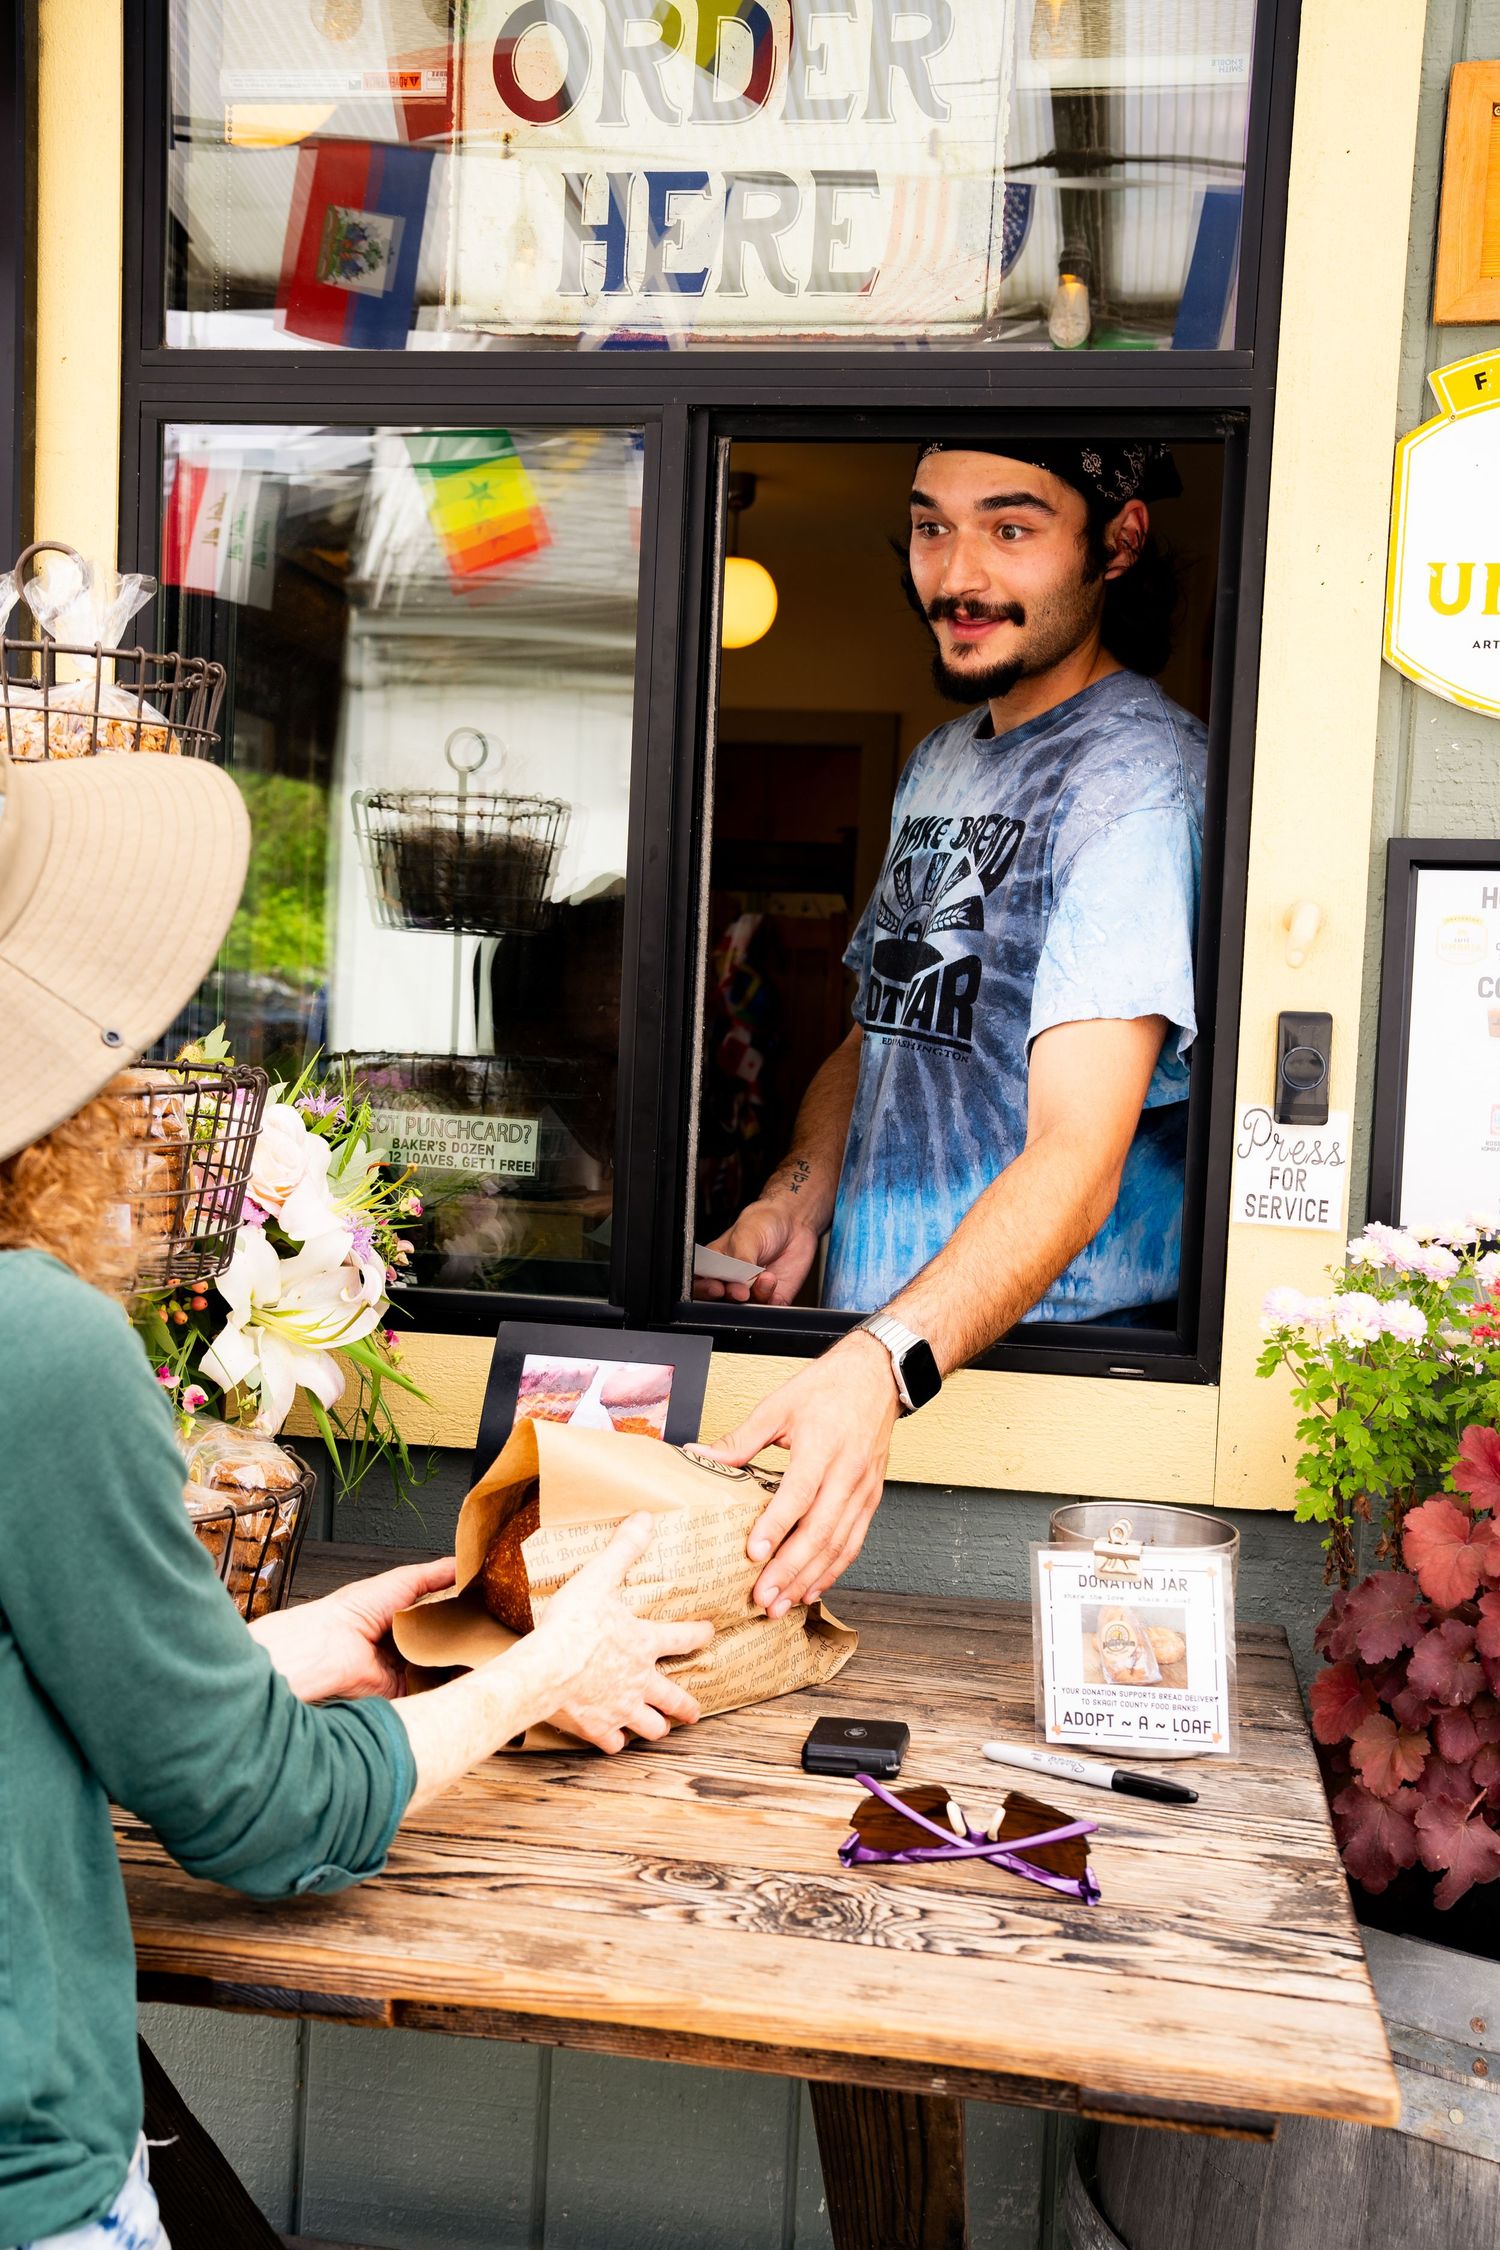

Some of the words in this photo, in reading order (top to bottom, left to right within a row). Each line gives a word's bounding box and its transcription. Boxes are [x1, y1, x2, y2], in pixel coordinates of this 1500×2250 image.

[493, 0, 954, 127] ORDER
[555, 169, 881, 297] HERE
[883, 815, 954, 880] MAKE
[949, 813, 1026, 898] BREAD
[405, 1116, 533, 1145] PUNCHCARD?
[1237, 1107, 1346, 1167] Press
[392, 1138, 447, 1153] BAKER'S
[452, 1141, 495, 1156] DOZEN
[389, 1151, 402, 1163] 12
[406, 1152, 458, 1169] LOAVES,
[462, 1156, 484, 1170] GET
[490, 1158, 496, 1170] 1
[499, 1160, 536, 1174] FREE!
[1269, 1166, 1307, 1193] FOR
[1245, 1193, 1329, 1224] SERVICE
[557, 1536, 602, 1562] Bread
[658, 1536, 692, 1566] fertile
[1161, 1577, 1188, 1592] JAR
[1061, 1687, 1080, 1695] YOUR
[1082, 1688, 1117, 1697] DONATION
[1119, 1690, 1156, 1699] SUPPORTS
[1158, 1693, 1182, 1701] BREAD
[1185, 1695, 1219, 1703] DELIVERY
[1081, 1698, 1090, 1706] TO
[1092, 1699, 1117, 1707] SKAGIT
[1120, 1700, 1149, 1709] COUNTY
[1151, 1702, 1170, 1710] FOOD
[1063, 1711, 1115, 1728] ADOPT
[1138, 1715, 1149, 1730] A
[1173, 1718, 1212, 1735] LOAF
